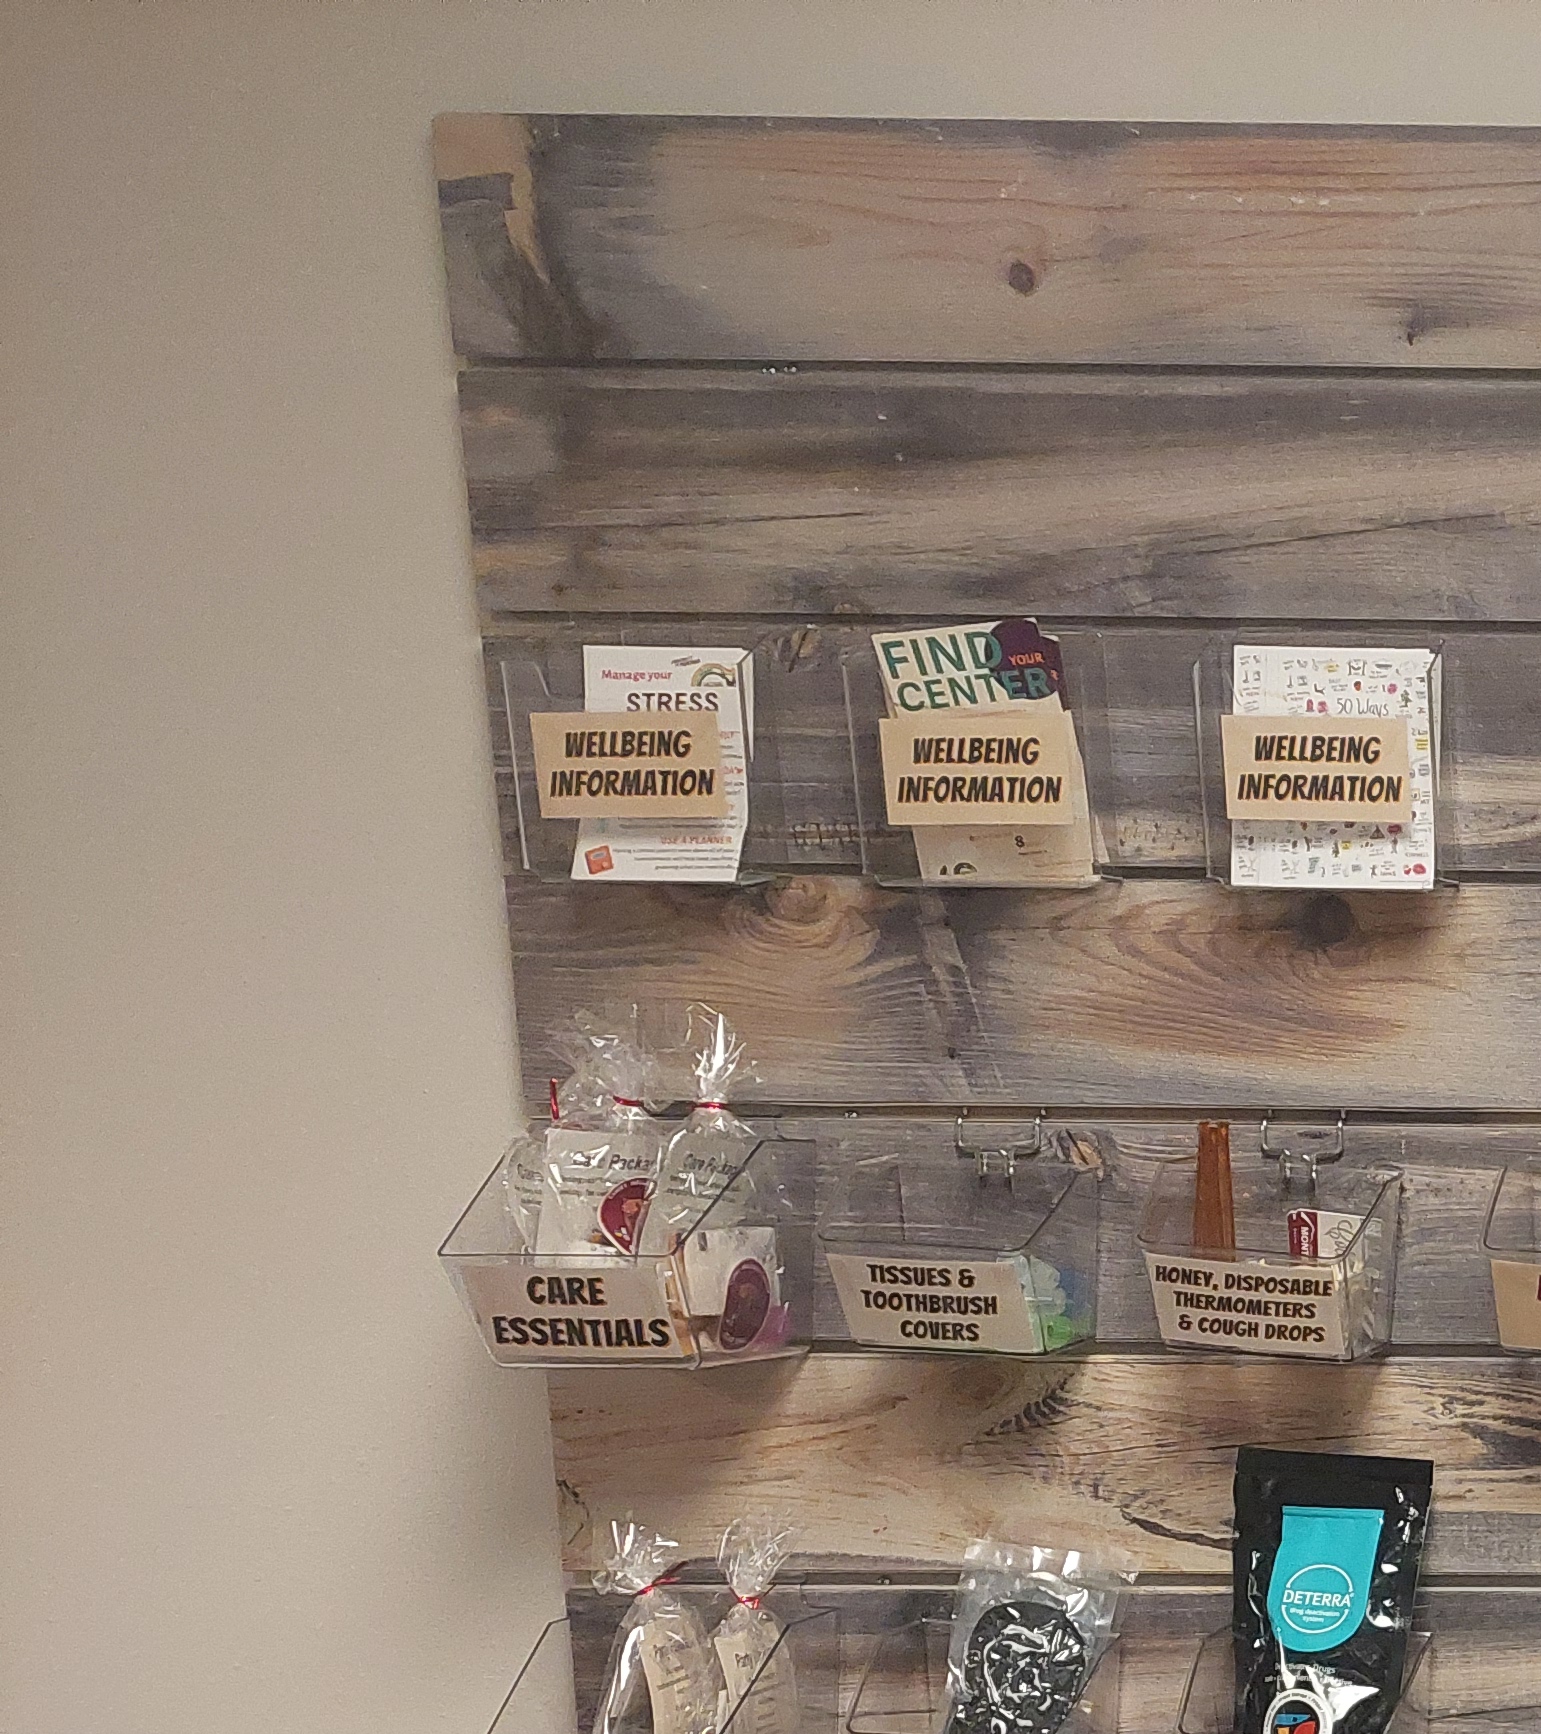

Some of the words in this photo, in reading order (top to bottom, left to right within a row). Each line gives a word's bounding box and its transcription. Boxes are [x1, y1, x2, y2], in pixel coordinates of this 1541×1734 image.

[601, 669, 646, 681] Manage
[647, 671, 672, 682] your
[626, 692, 719, 712] STRESS
[1337, 698, 1352, 714] 50
[1357, 699, 1389, 717] Ways
[565, 730, 692, 758] WELLBEING
[913, 737, 1040, 765] WELLBEING
[1254, 735, 1381, 764] WELLBEING
[550, 769, 715, 797] INFORMATION
[898, 776, 1062, 803] INFORMATION
[1237, 774, 1402, 802] INFORMATION
[866, 1263, 952, 1287] TISSUES
[958, 1269, 975, 1287] &
[1155, 1265, 1218, 1291] HONEY,
[1224, 1273, 1333, 1297] DISPOSABLE
[527, 1276, 608, 1306] CARE
[861, 1289, 998, 1315] TOOTHBRUSH
[1173, 1290, 1316, 1319] THERMOMETERS
[492, 1316, 670, 1347] ESSENTIALS
[900, 1320, 980, 1341] COVERS
[1178, 1314, 1193, 1330] &
[1197, 1317, 1258, 1338] COUGH
[1264, 1323, 1325, 1342] DROPS
[1282, 1589, 1352, 1608] DETERRA
